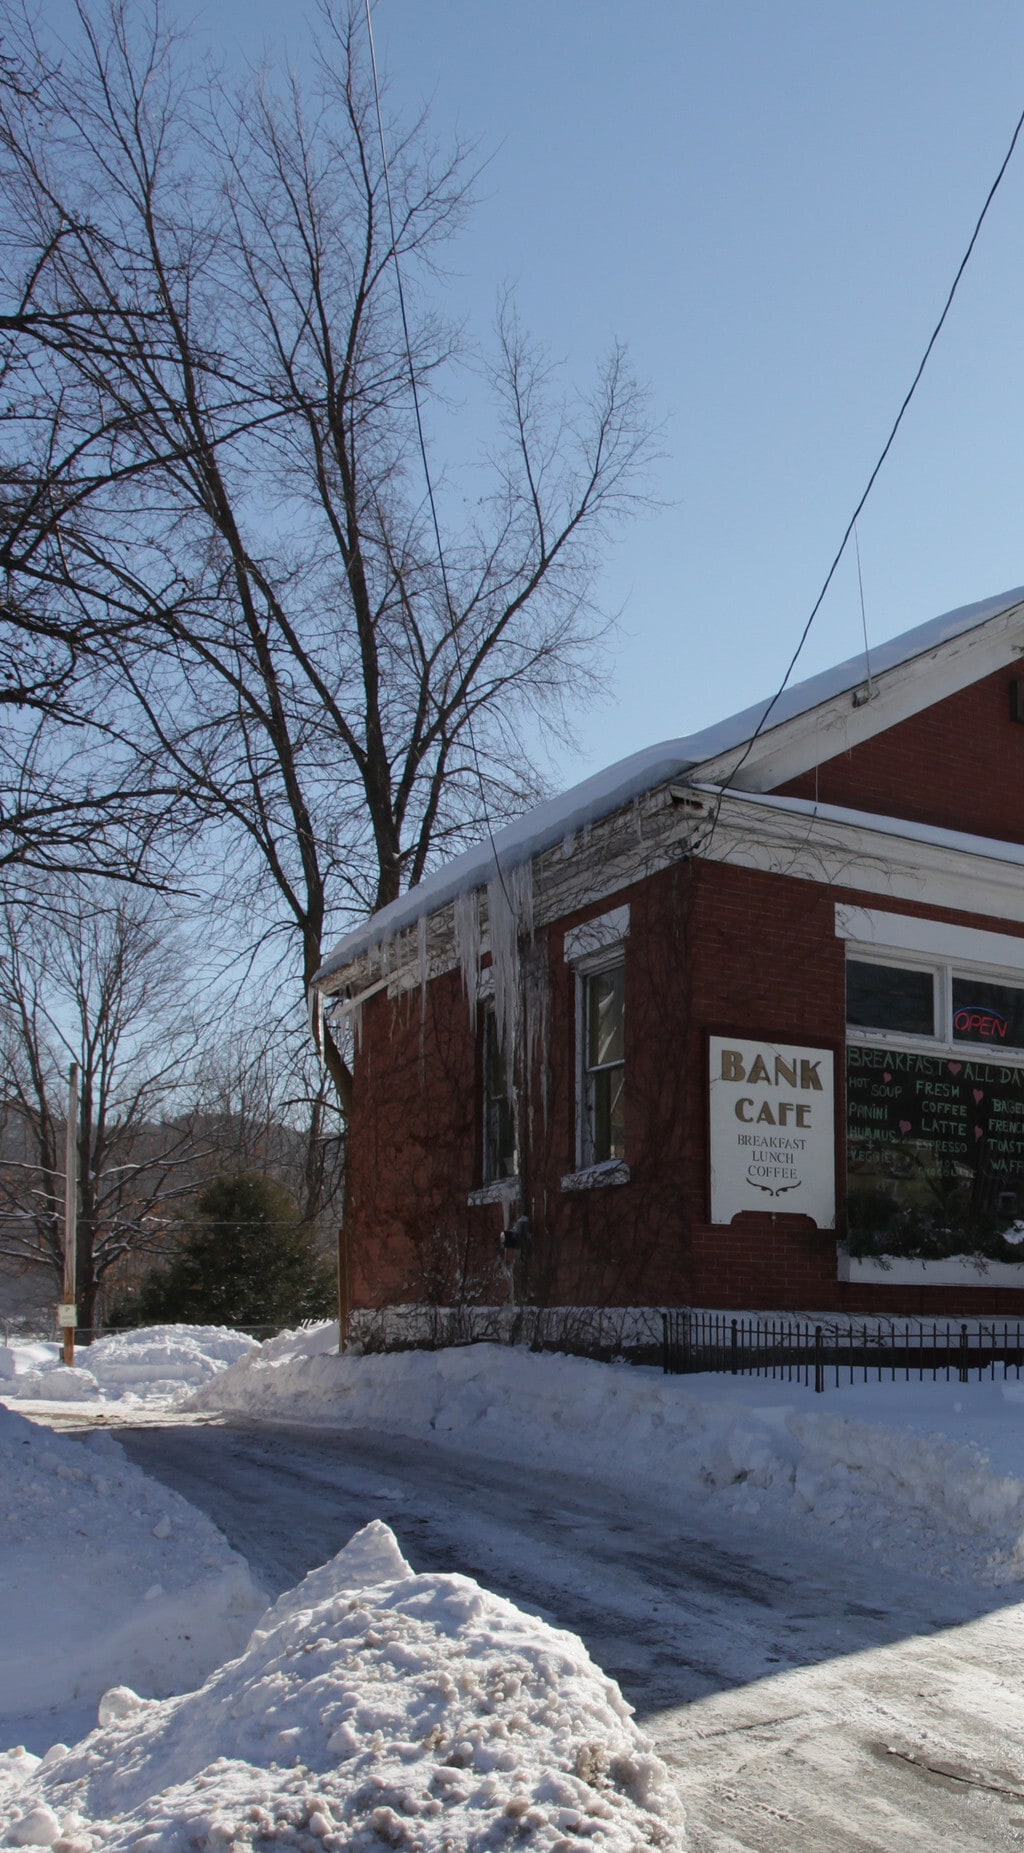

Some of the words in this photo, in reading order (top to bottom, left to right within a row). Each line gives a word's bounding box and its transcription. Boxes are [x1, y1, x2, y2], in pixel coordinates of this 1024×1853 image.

[954, 1011, 1008, 1038] OPEN
[721, 1049, 823, 1091] BANK
[847, 1047, 947, 1076] BREAKFAST
[963, 1062, 994, 1083] ALL
[848, 1076, 870, 1089] HOT
[871, 1084, 902, 1098] SOUP
[915, 1080, 960, 1098] FRESH
[734, 1097, 812, 1129] CAFE
[921, 1100, 968, 1117] COFFEE
[848, 1125, 897, 1142] HUMMUS
[921, 1118, 967, 1136] LATTE
[737, 1134, 807, 1150] BREAKFAST
[915, 1138, 968, 1153] ESPRESSO
[986, 1138, 1024, 1153] TOAST
[752, 1151, 794, 1164] LUNCH
[748, 1165, 797, 1179] COFFEE
